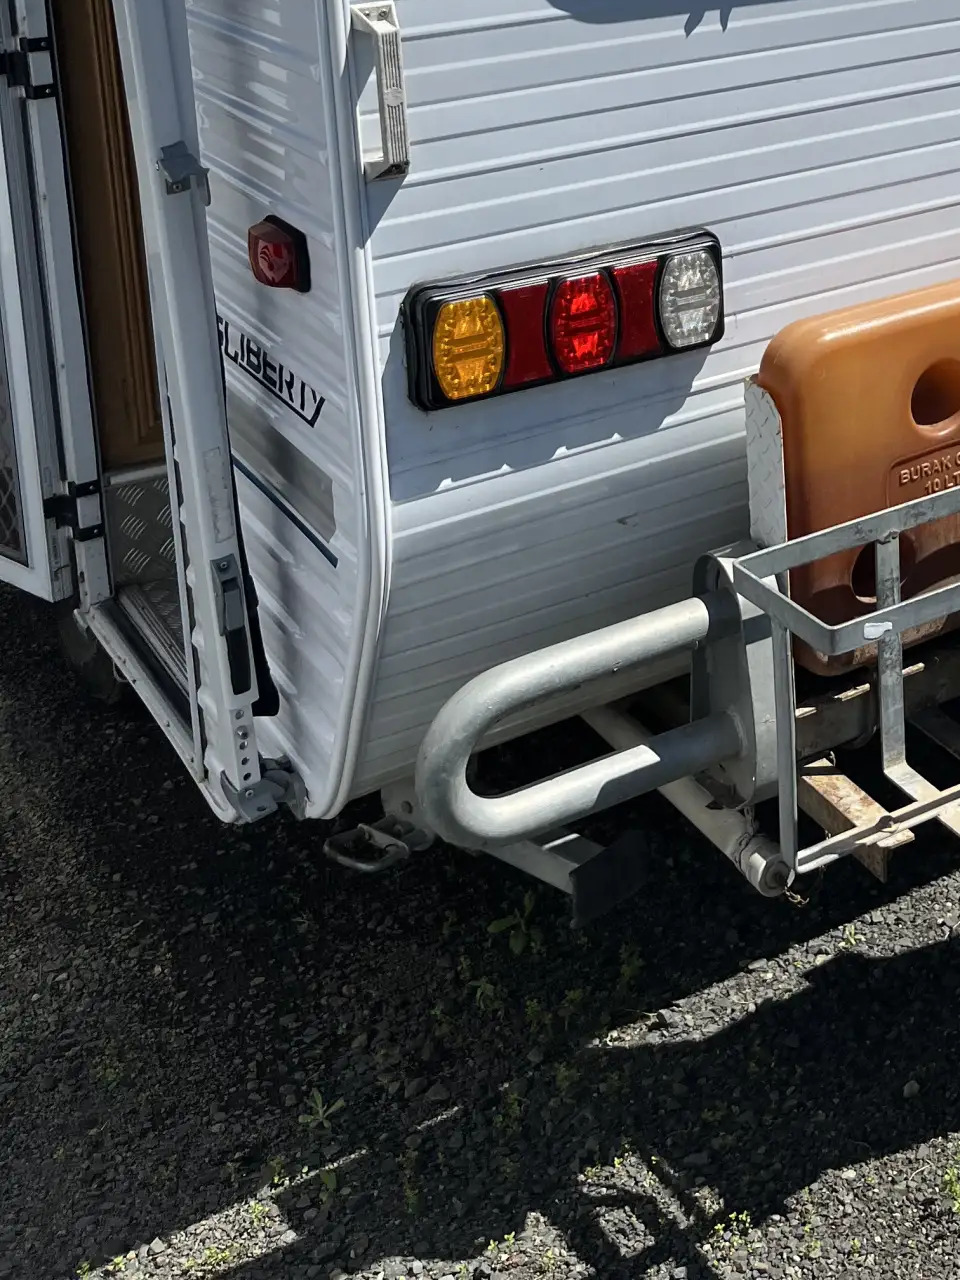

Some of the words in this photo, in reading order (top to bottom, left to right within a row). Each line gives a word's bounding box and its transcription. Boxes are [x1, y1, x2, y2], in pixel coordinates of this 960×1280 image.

[224, 320, 326, 428] LIBERTY
[899, 455, 952, 486] BURAK
[925, 479, 942, 495] 10
